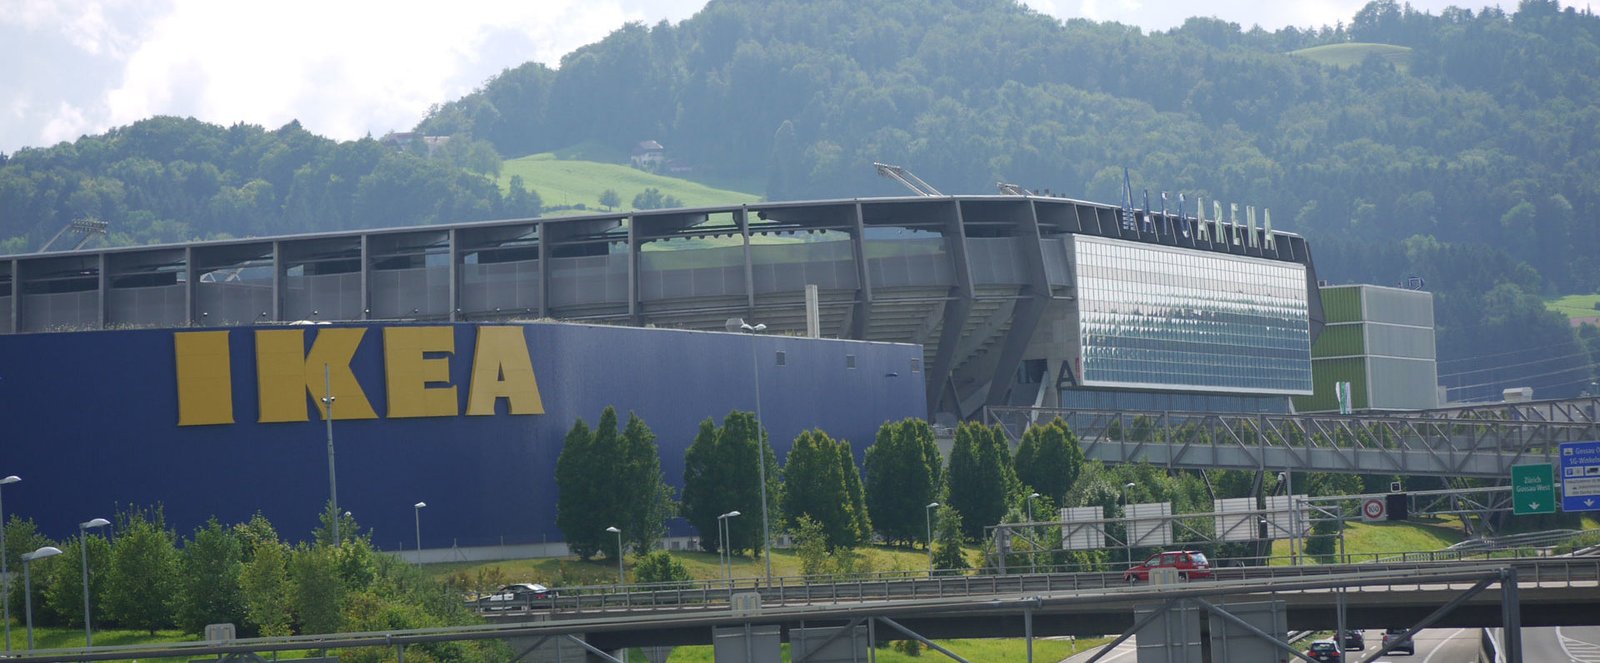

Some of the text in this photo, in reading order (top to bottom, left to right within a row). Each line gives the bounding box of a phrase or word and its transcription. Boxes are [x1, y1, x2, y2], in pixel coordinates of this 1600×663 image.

[1197, 197, 1275, 251] ARENA
[174, 326, 545, 426] IKEA
[1056, 360, 1077, 388] A
